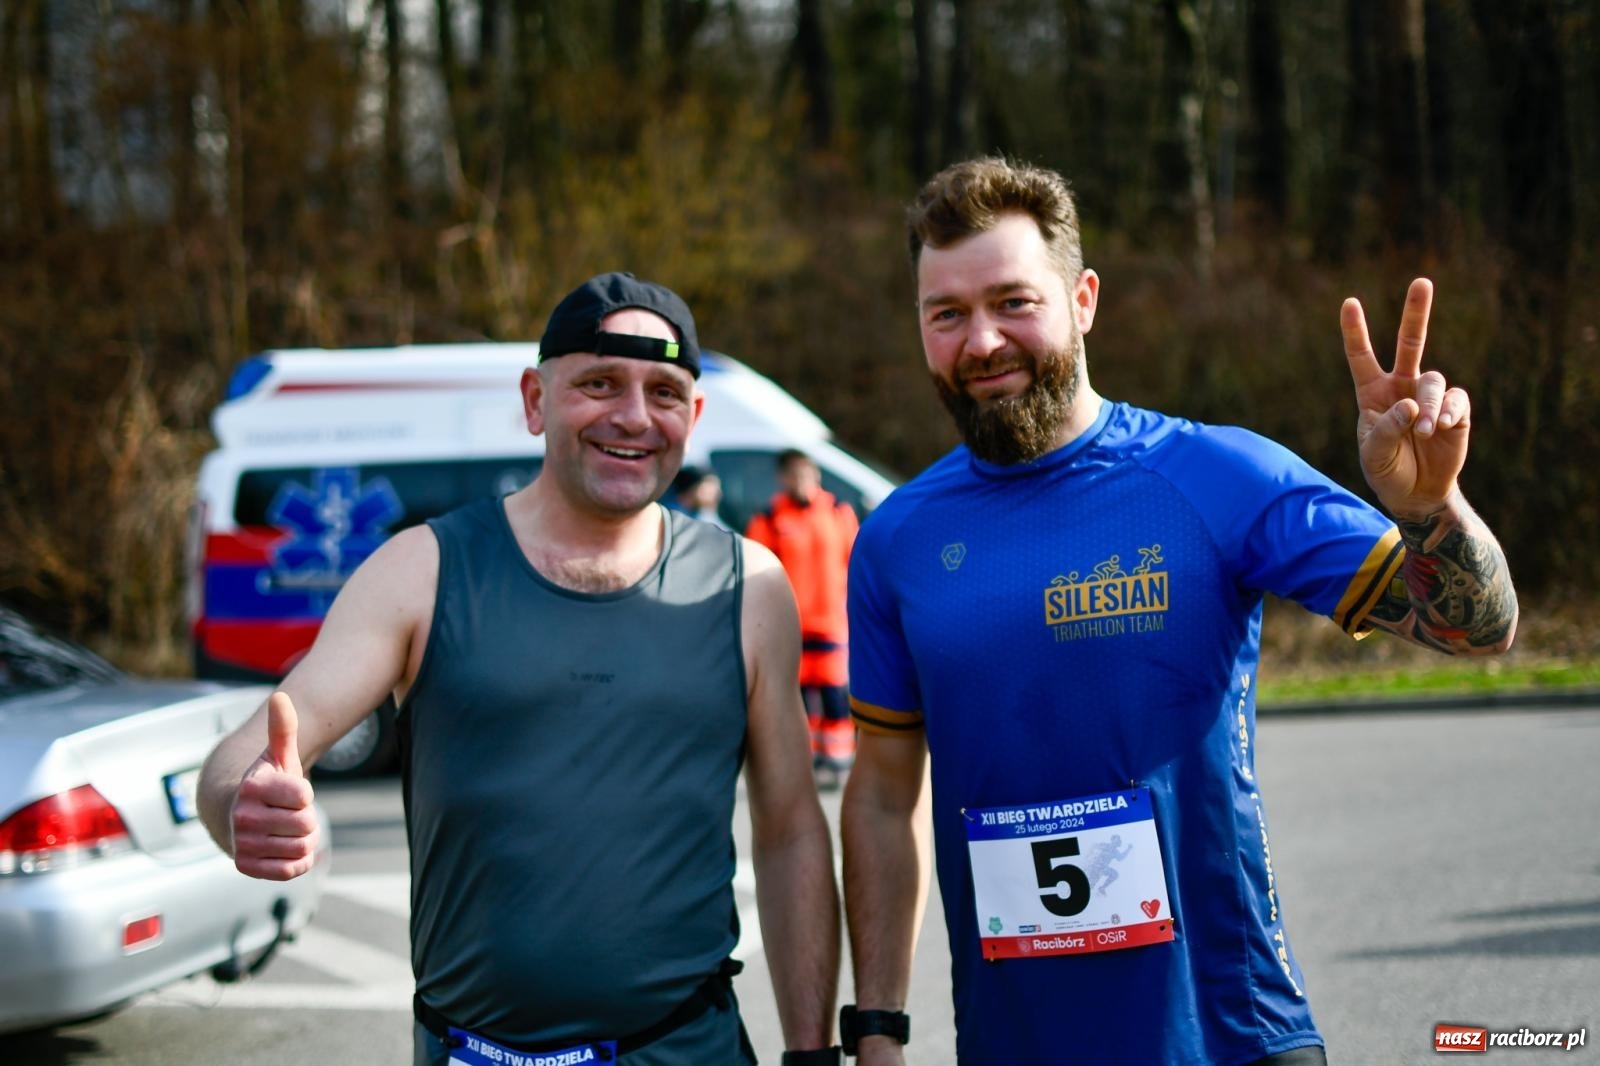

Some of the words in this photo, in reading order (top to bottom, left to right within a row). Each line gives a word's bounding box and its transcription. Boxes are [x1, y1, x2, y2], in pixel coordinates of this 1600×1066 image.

[1049, 575, 1165, 619] SILESIAN
[1053, 618, 1125, 642] TRIATHLON
[1128, 614, 1164, 633] TEAM
[981, 811, 997, 826] XII
[998, 809, 1026, 824] BIEG
[1027, 795, 1128, 822] TWARDZIELA
[1015, 824, 1027, 835] 25
[1027, 821, 1059, 835] lutego
[1059, 817, 1085, 830] 2024
[1030, 836, 1091, 917] 5
[1032, 936, 1086, 951] Racibórz
[1096, 930, 1127, 945] OSiR
[466, 1036, 480, 1053] XII
[480, 1040, 504, 1062] BIEG
[503, 1048, 595, 1066] TWARDZIELA
